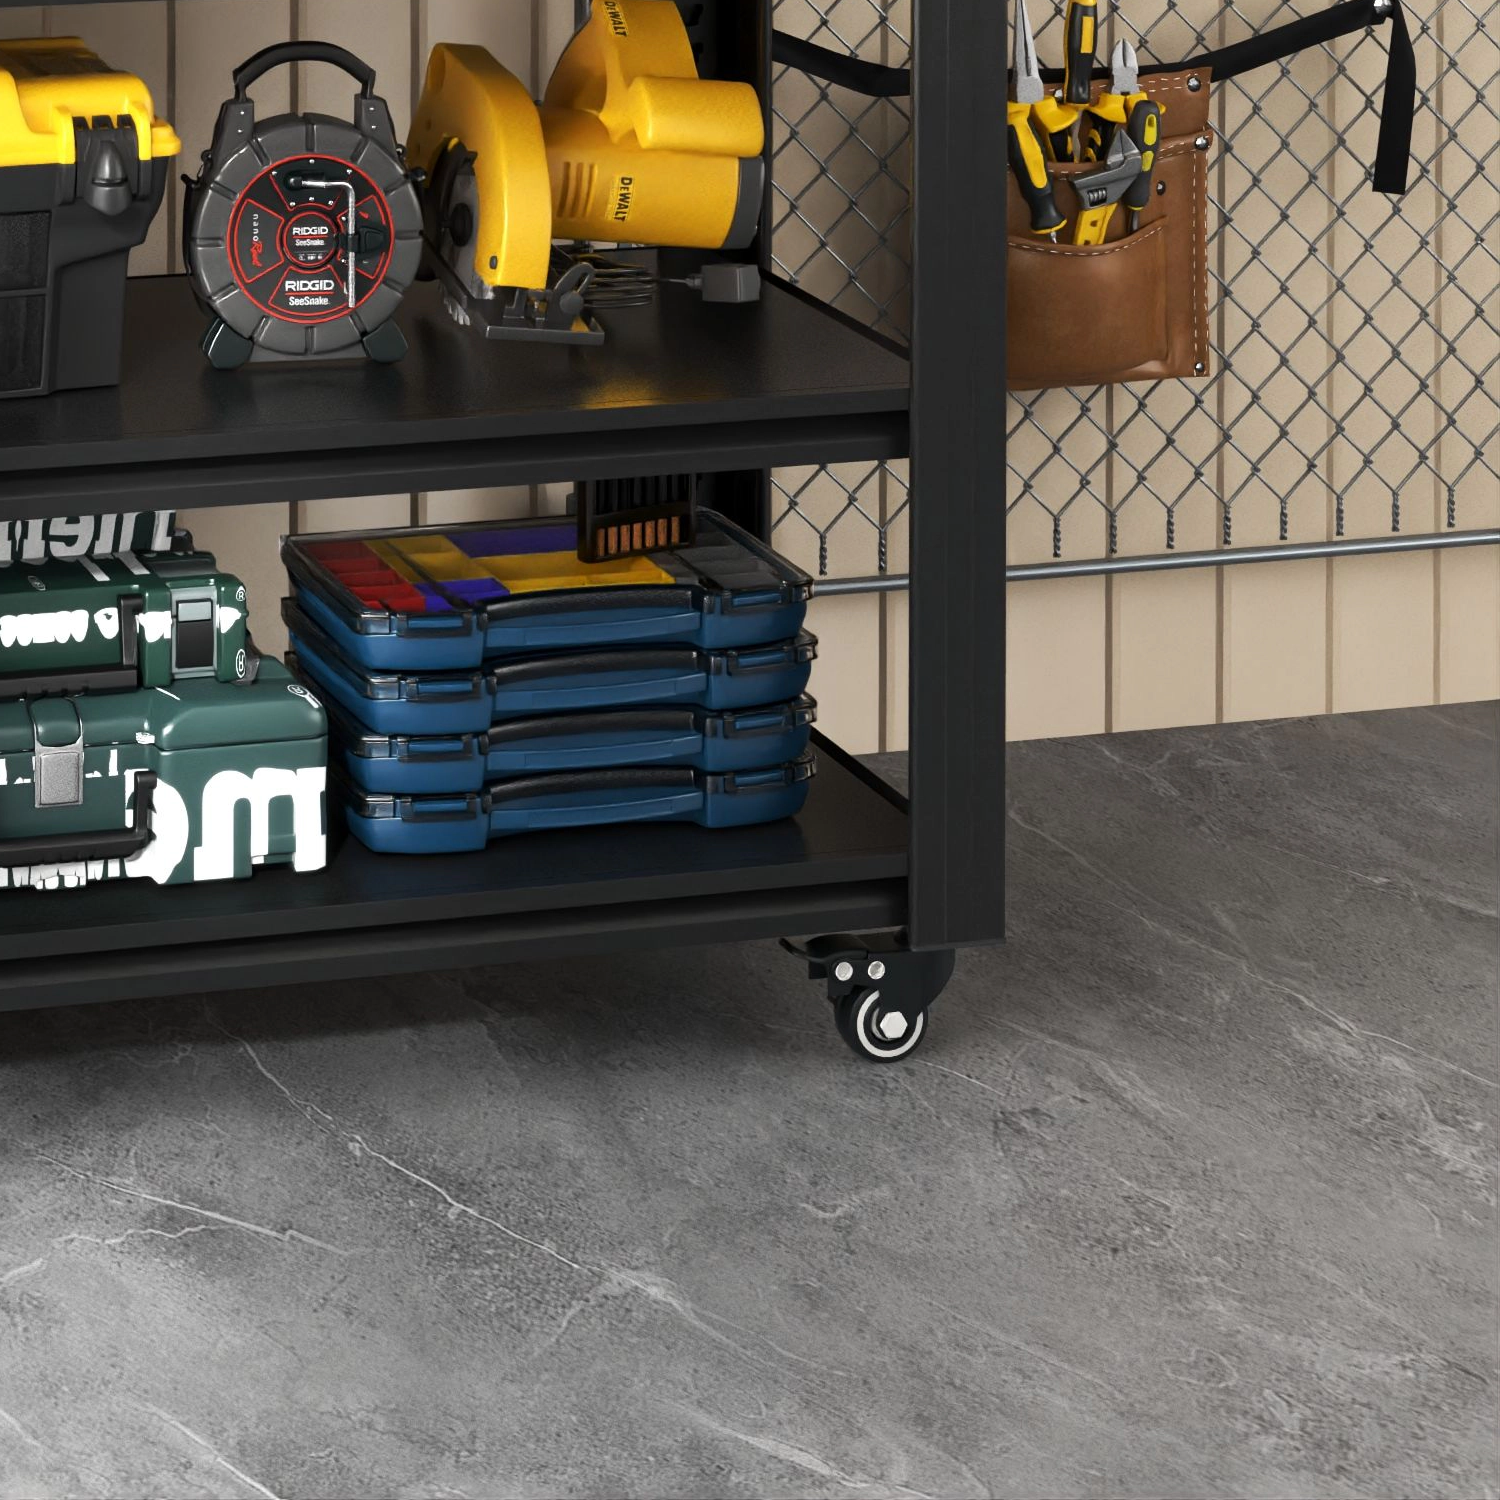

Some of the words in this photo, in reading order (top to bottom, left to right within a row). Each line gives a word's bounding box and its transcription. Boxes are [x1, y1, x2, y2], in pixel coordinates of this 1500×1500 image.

[292, 226, 329, 236] RIDGID
[295, 238, 325, 247] SeeSnake
[284, 279, 335, 292] RIDGID
[288, 295, 330, 307] SeeSnake
